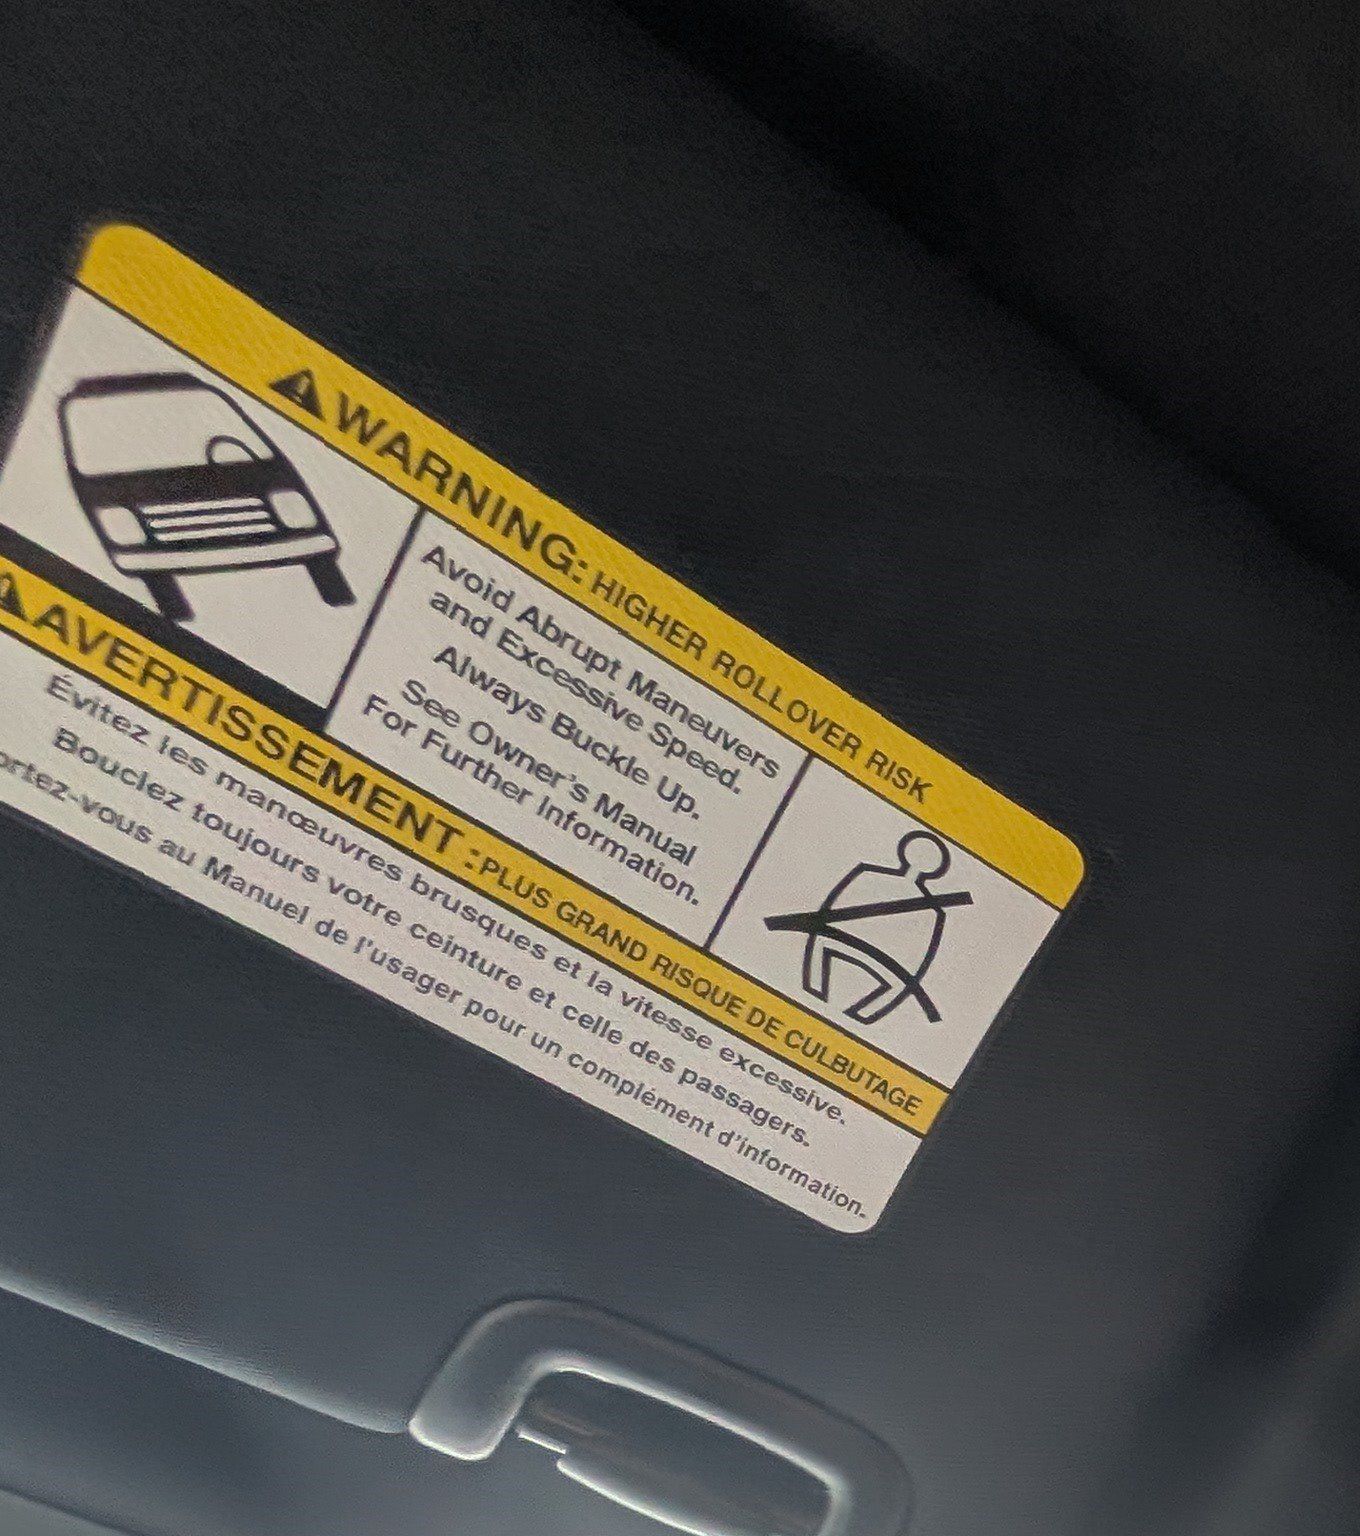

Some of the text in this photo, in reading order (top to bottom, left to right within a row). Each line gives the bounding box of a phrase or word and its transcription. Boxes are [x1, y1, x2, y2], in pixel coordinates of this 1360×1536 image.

[337, 398, 933, 804] WARNING: HIGHER ROLLOVER RISK
[421, 545, 780, 778] Avoid Abrupt Maneuvers
[428, 591, 741, 794] and Excessive Speed.
[361, 693, 698, 905] For Further Information.
[400, 679, 461, 728] See
[593, 793, 698, 866] Manual
[433, 646, 700, 820] Always Buckle Up.
[45, 674, 845, 1125] Évitez les manœuvres brusques et la vitesse excessive.
[52, 727, 809, 1147] Bouclez toujours votre ceinture et celle des passagers.
[157, 839, 197, 867] au
[201, 856, 310, 925] Manuel
[313, 918, 349, 946] de
[462, 998, 527, 1038] pour
[530, 1031, 563, 1059] un
[567, 1053, 715, 1138] complément
[555, 901, 648, 962] GRAND
[650, 953, 747, 1018] RISQUE
[745, 1006, 785, 1040] DE
[784, 1029, 923, 1116] CULBUTAGE
